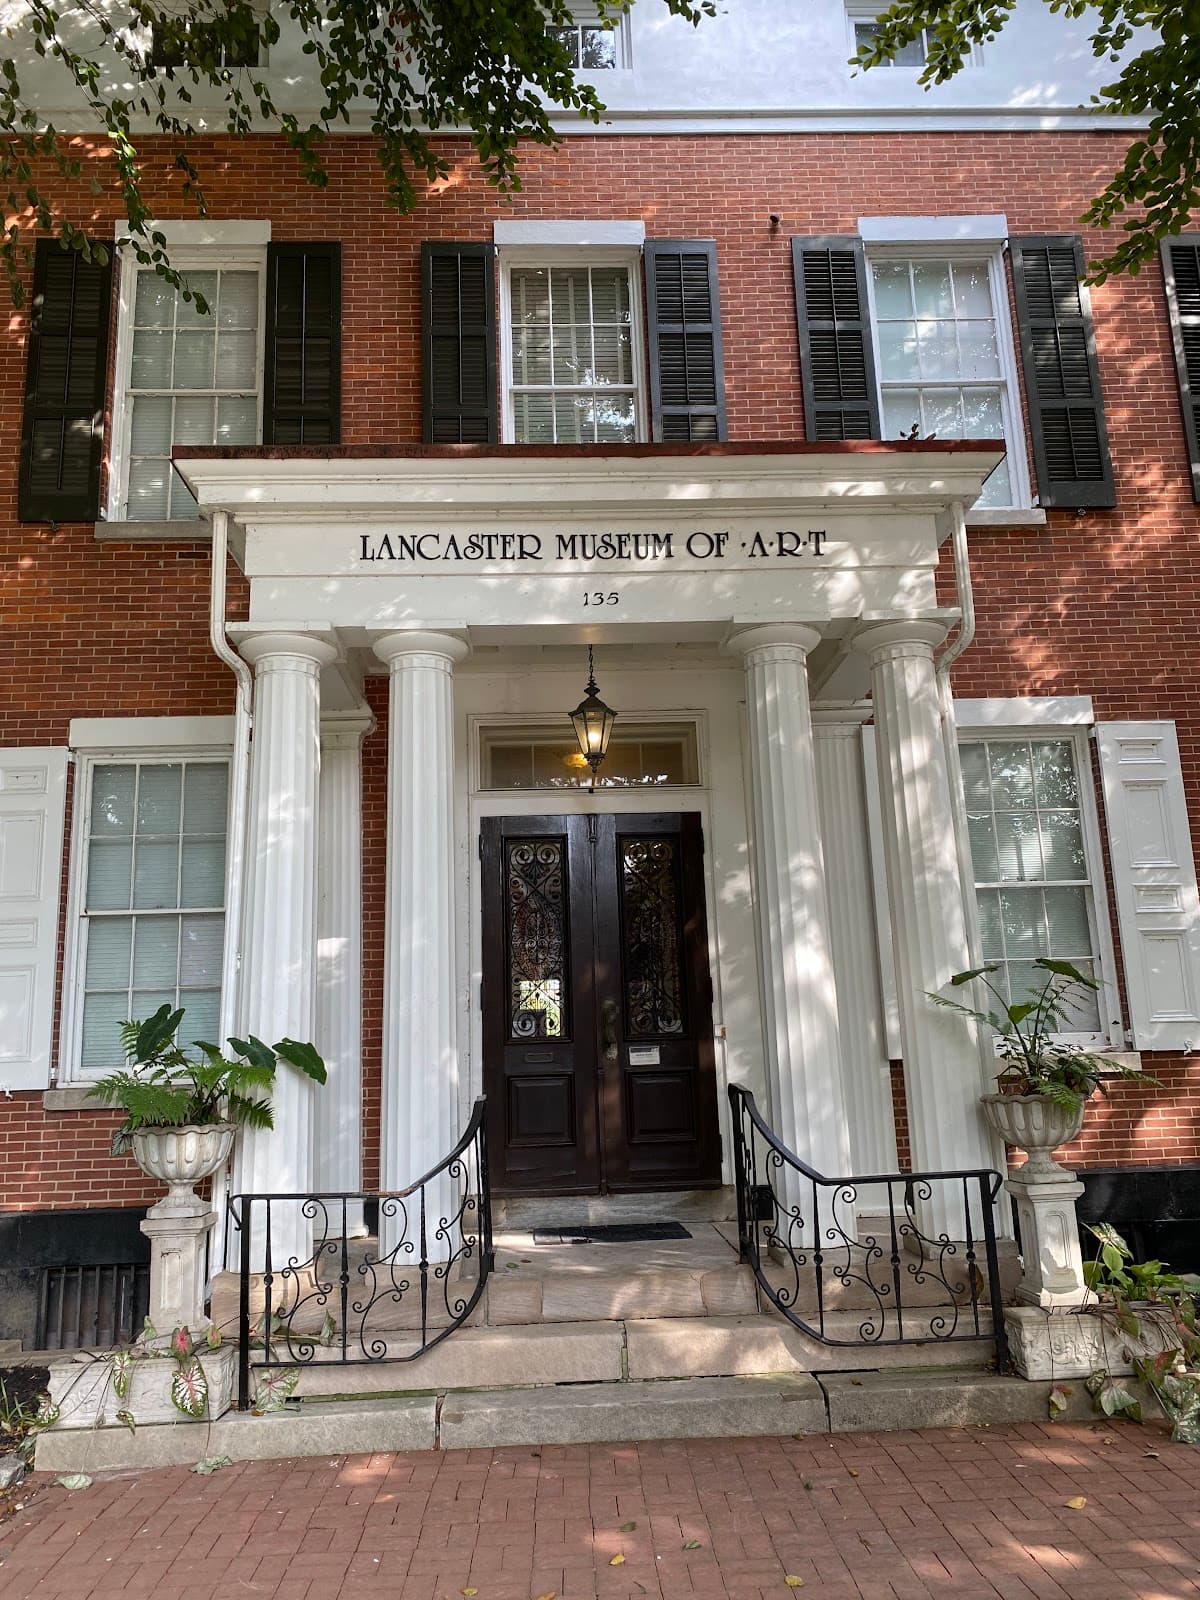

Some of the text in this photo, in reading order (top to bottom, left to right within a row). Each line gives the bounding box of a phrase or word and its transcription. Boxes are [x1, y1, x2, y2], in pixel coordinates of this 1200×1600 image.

[360, 533, 543, 561] LANCASTER
[556, 533, 675, 560] MUSEUM
[686, 531, 729, 559] OF
[583, 592, 619, 606] 135
